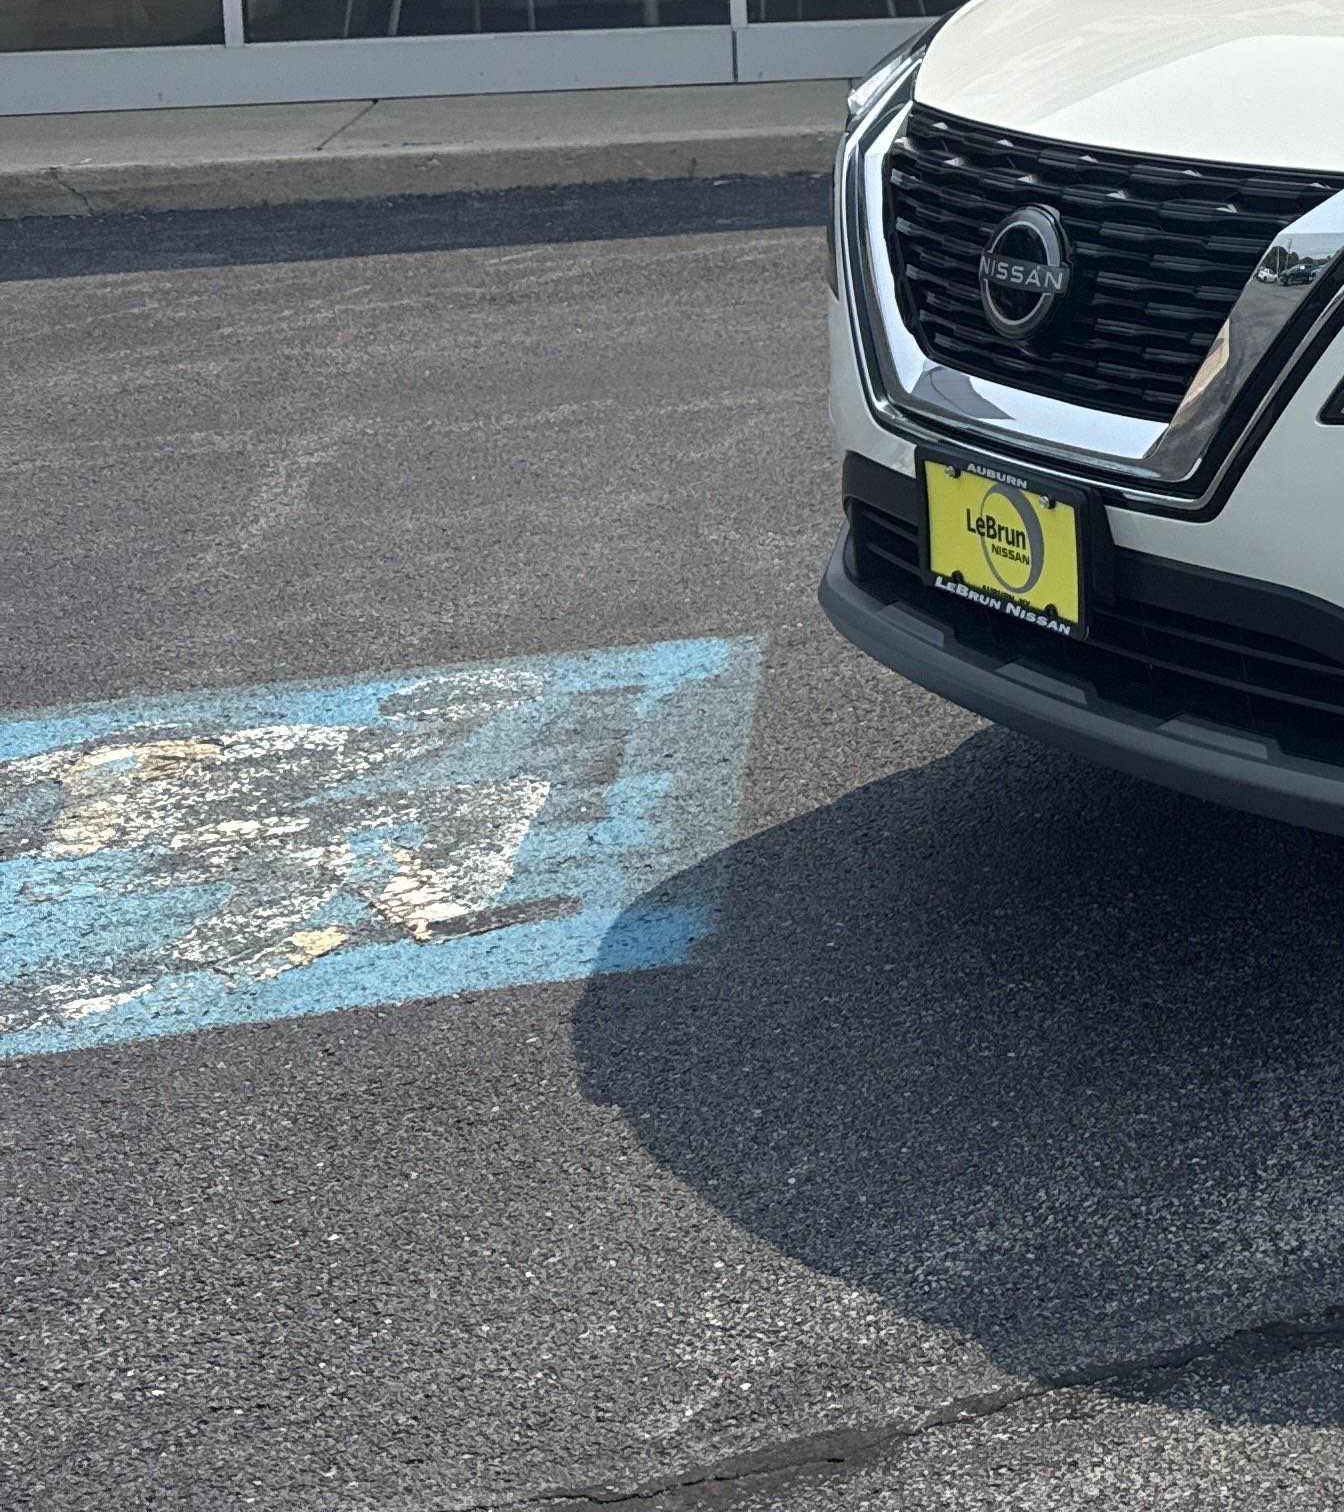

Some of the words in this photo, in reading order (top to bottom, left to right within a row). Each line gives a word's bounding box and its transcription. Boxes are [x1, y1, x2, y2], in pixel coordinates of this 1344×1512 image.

[980, 255, 1063, 290] NISSAN
[966, 463, 1028, 489] AUBURN
[966, 508, 1027, 551] LeBrun
[991, 543, 1030, 566] NISSAN
